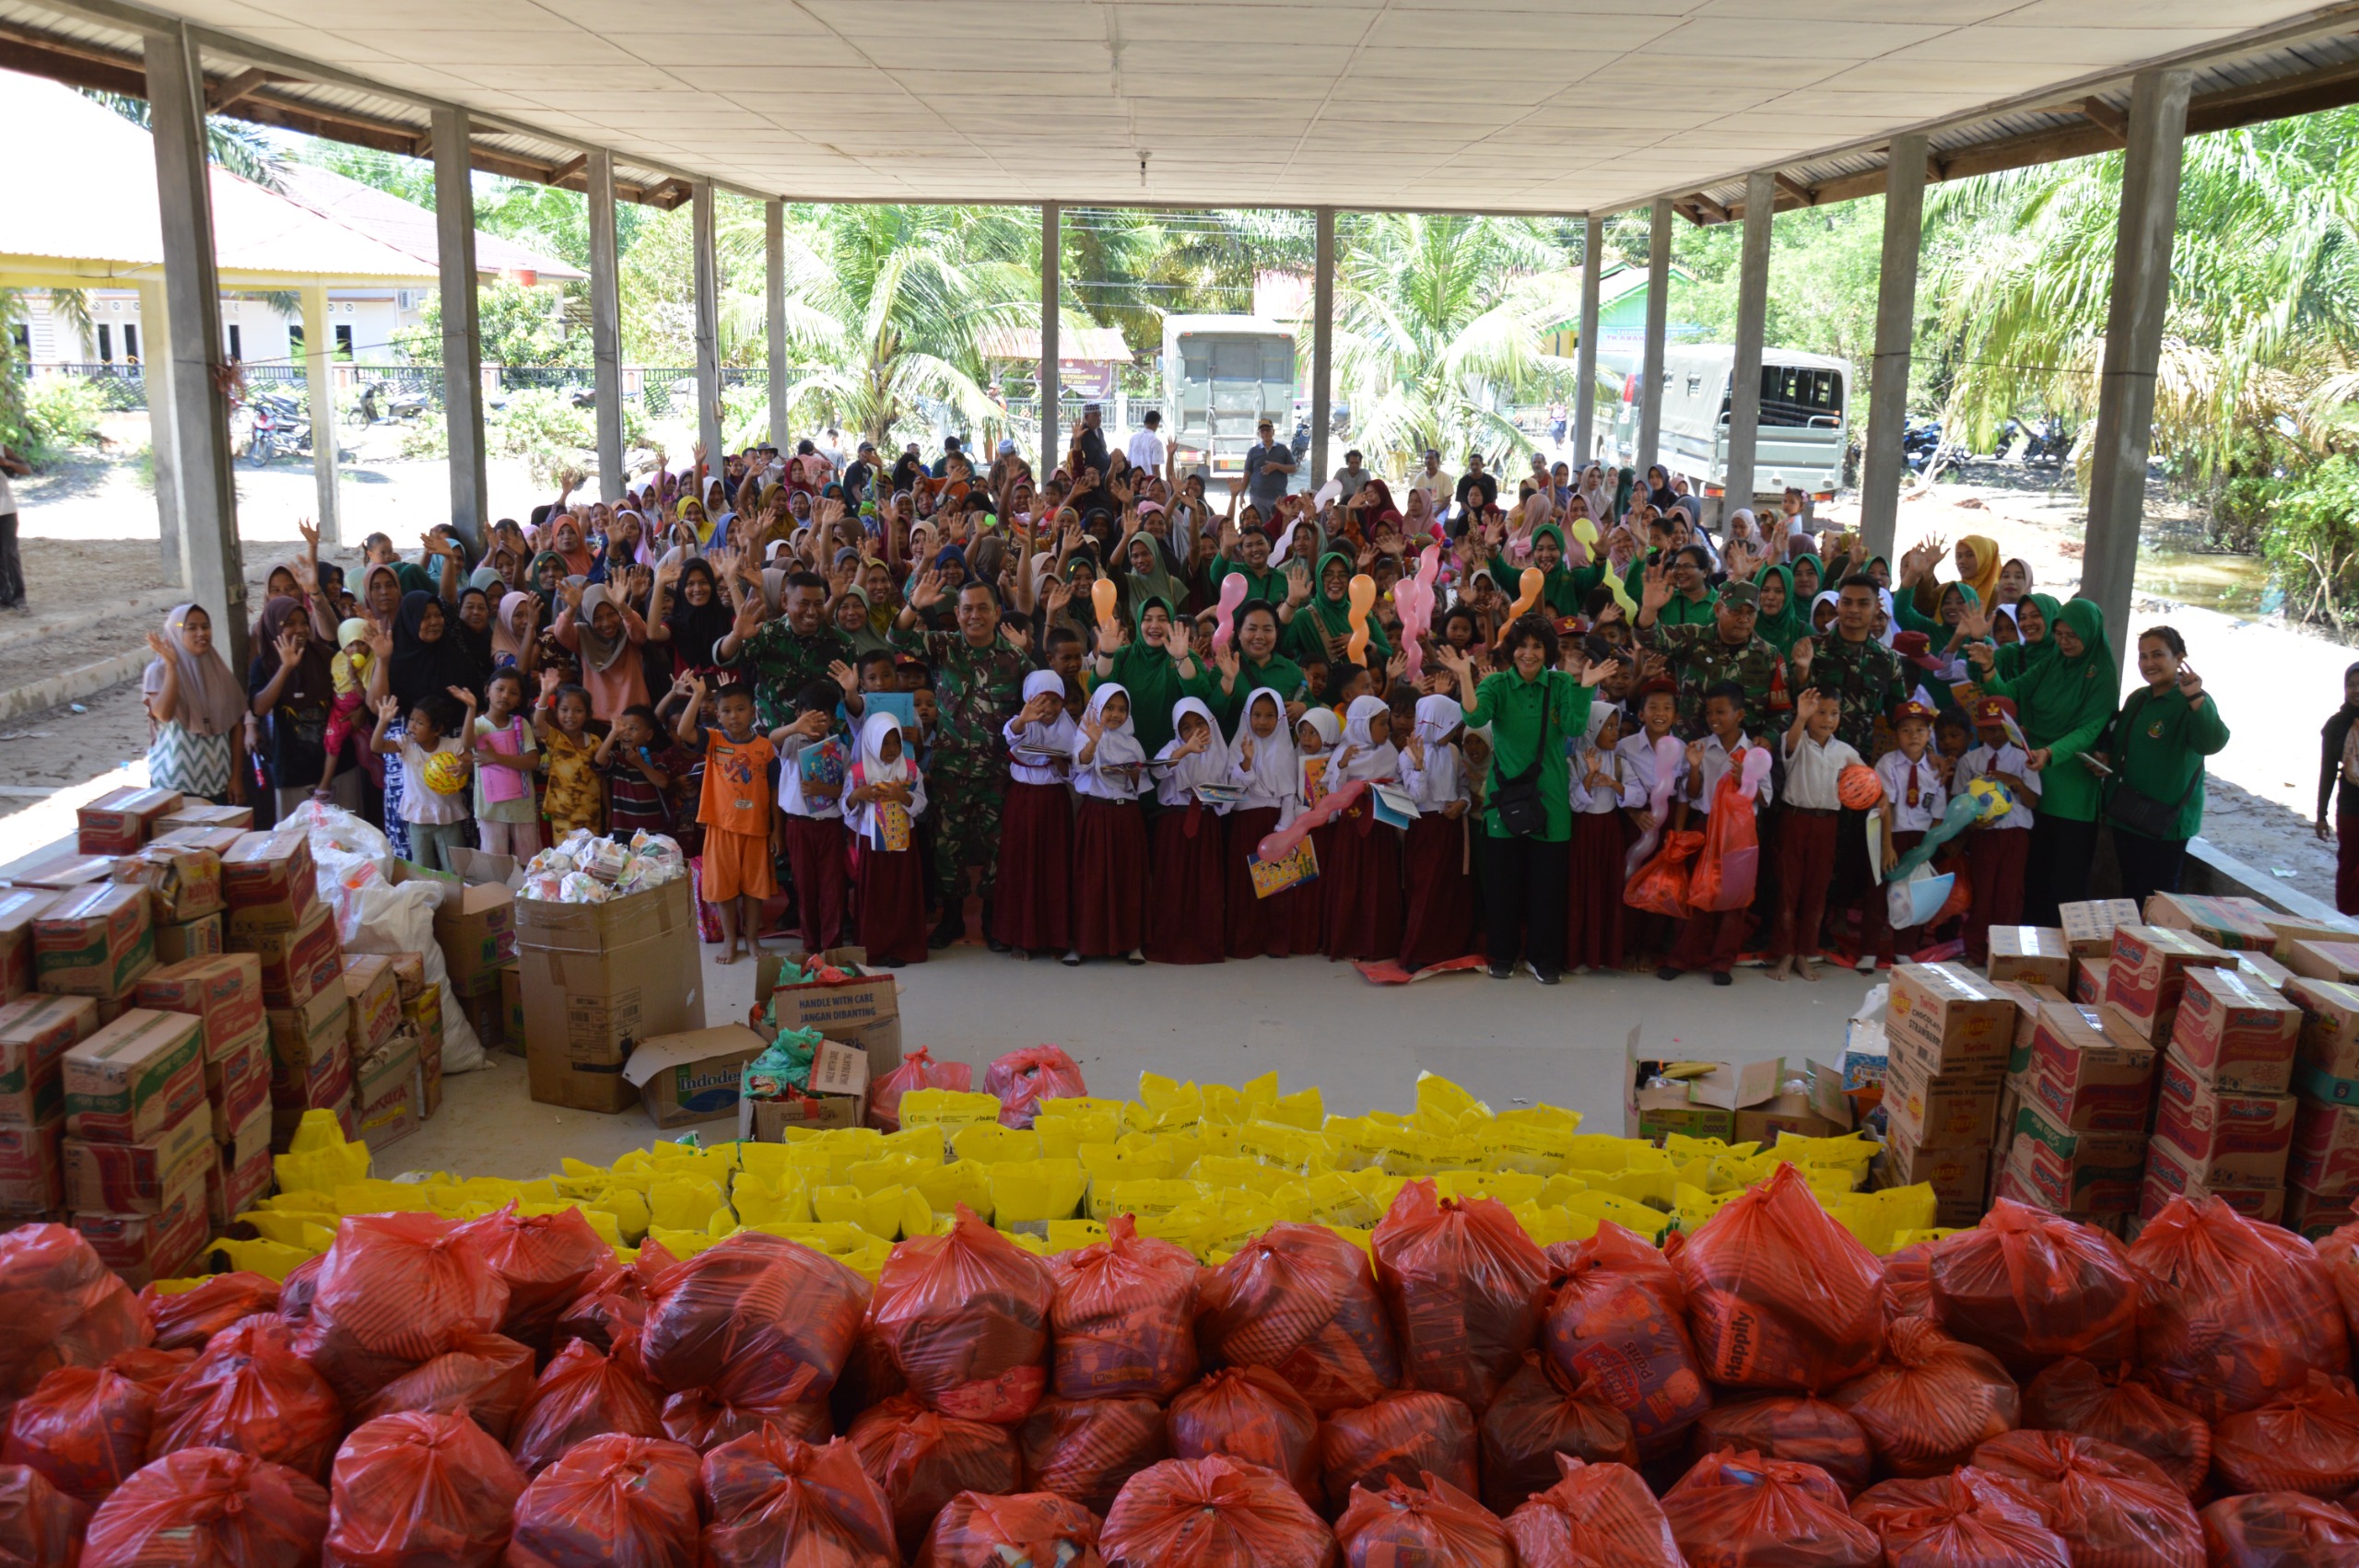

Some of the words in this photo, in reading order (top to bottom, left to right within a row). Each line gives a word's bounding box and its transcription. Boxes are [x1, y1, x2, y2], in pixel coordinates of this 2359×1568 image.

[799, 997, 831, 1010] HANDLE
[832, 995, 853, 1006] WITH
[855, 993, 874, 1004] CARE
[800, 1012, 832, 1024] JANGAN
[833, 1007, 876, 1020] DIBANTING
[1392, 1149, 1411, 1159] bulog
[1546, 1151, 1565, 1160] bulog
[1724, 1310, 1755, 1379] Happily
[1620, 1339, 1656, 1382] Pants
